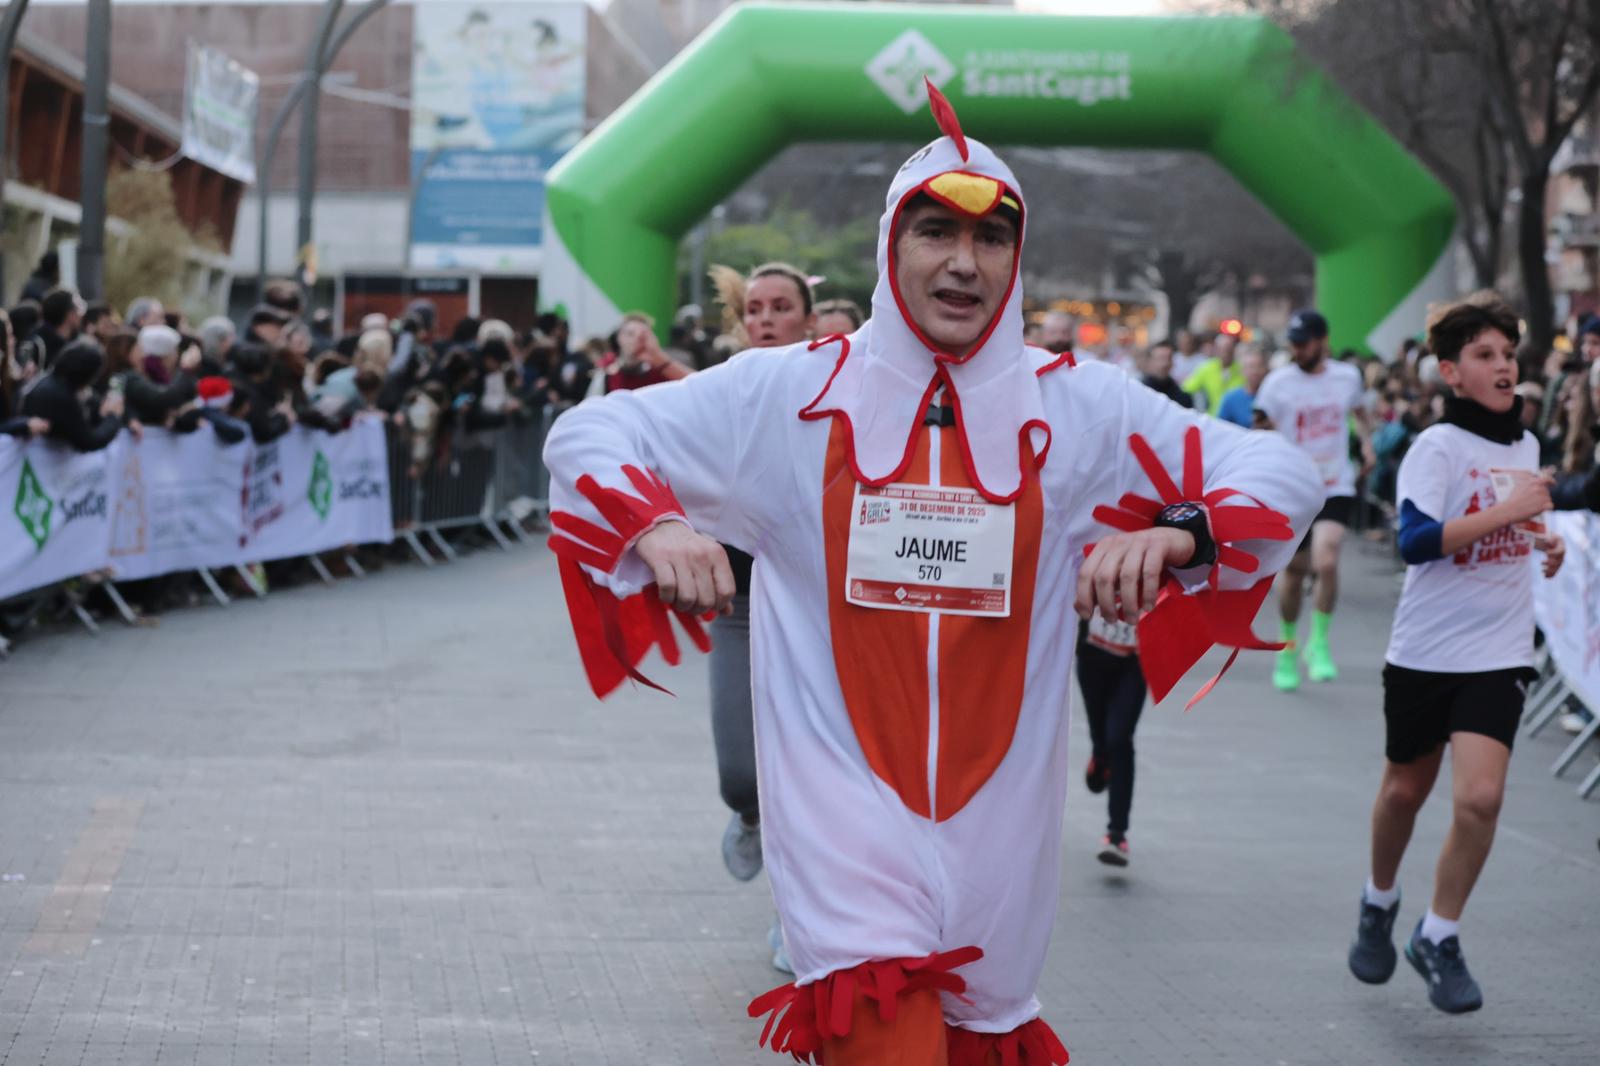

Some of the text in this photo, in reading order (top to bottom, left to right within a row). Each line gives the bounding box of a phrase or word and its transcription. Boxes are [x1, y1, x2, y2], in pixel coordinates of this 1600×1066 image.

[963, 68, 1132, 106] SantCugat
[899, 501, 908, 512] 31
[909, 502, 917, 512] DE
[920, 504, 955, 515] DESEMBRE
[957, 506, 965, 515] DE
[895, 537, 967, 562] JAUME
[918, 564, 942, 581] 570
